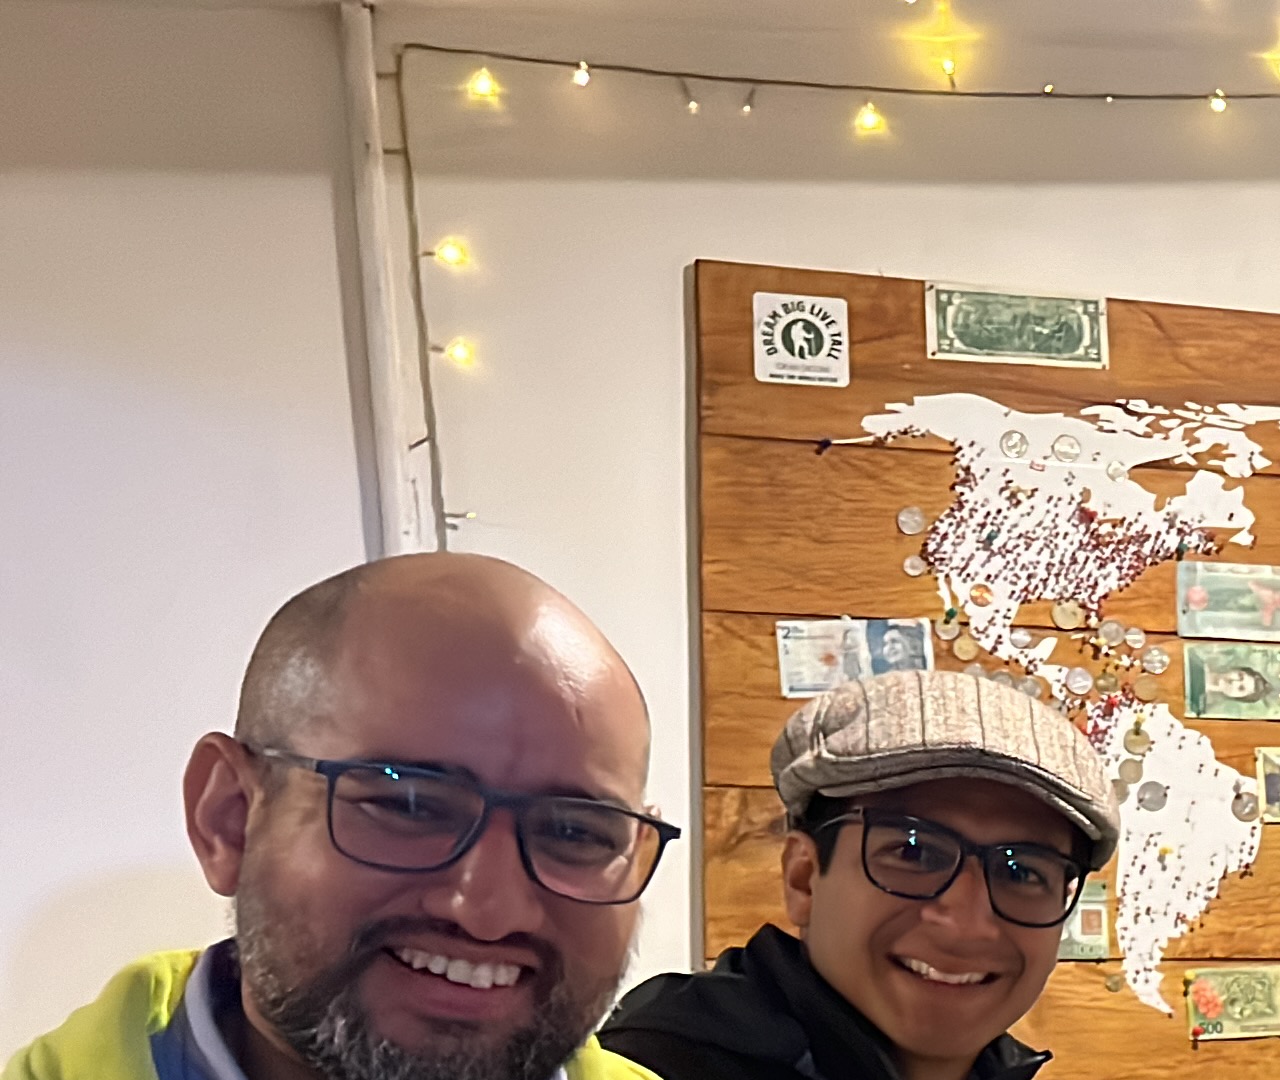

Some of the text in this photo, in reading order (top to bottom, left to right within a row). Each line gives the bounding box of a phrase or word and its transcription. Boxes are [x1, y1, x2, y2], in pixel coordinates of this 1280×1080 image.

[761, 301, 843, 360] DREAM BIG LIVE TALL
[782, 626, 791, 640] 2
